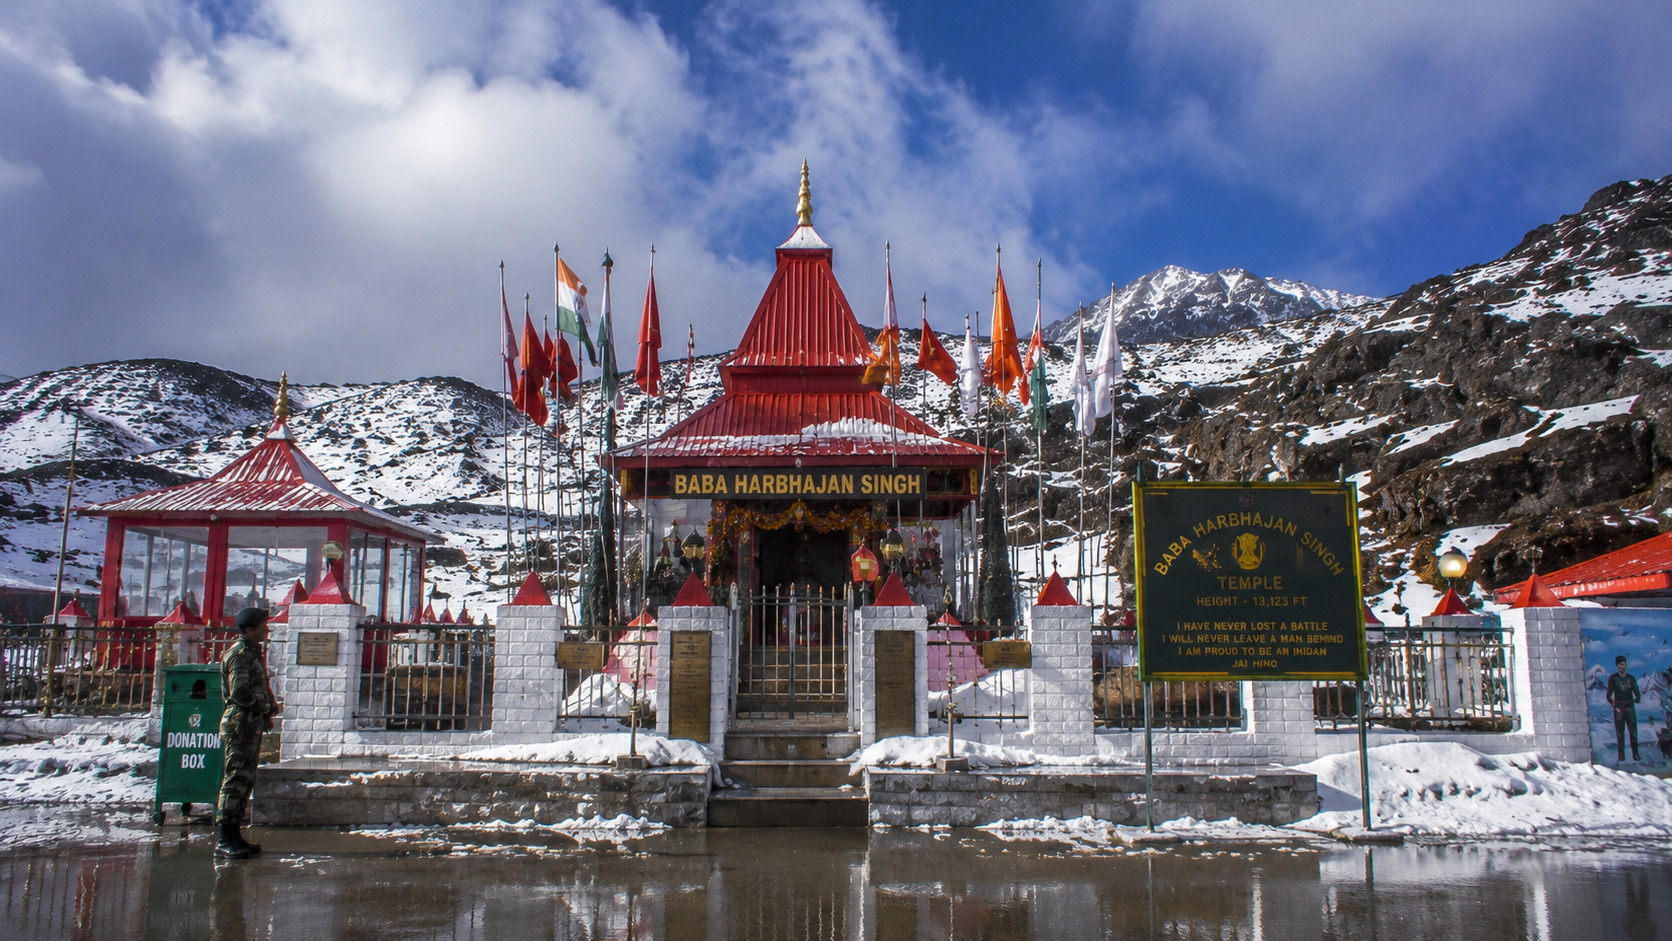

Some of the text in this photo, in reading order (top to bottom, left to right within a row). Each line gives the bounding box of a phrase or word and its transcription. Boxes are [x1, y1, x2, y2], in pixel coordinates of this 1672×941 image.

[675, 474, 920, 494] BABA HARBHAJAN SINGH
[1153, 511, 1344, 576] BABA HARBHAJAN SINGH
[1216, 576, 1283, 590] TEMPLE
[1196, 596, 1238, 607] HEIGHT
[1252, 596, 1289, 608] 13,123
[1293, 596, 1308, 607] FT
[1183, 622, 1210, 631] HAVE
[1214, 622, 1247, 631] NEVER
[1251, 622, 1276, 631] LOST
[1280, 622, 1287, 631] A
[1291, 622, 1328, 631] BATTLE
[1169, 634, 1194, 643] WILL
[1197, 634, 1230, 643] NEVER
[1233, 634, 1266, 643] LEAVE
[1270, 634, 1277, 643] A
[1281, 634, 1303, 643] MAN
[1307, 634, 1344, 643] BEHIND
[1186, 646, 1201, 656] AM
[1204, 646, 1239, 656] PROUD
[1242, 646, 1256, 656] TO
[1259, 646, 1272, 656] BE
[1276, 646, 1289, 656] AN
[1232, 659, 1248, 668] JAI
[167, 732, 221, 749] DONATION
[181, 754, 206, 769] BOX
